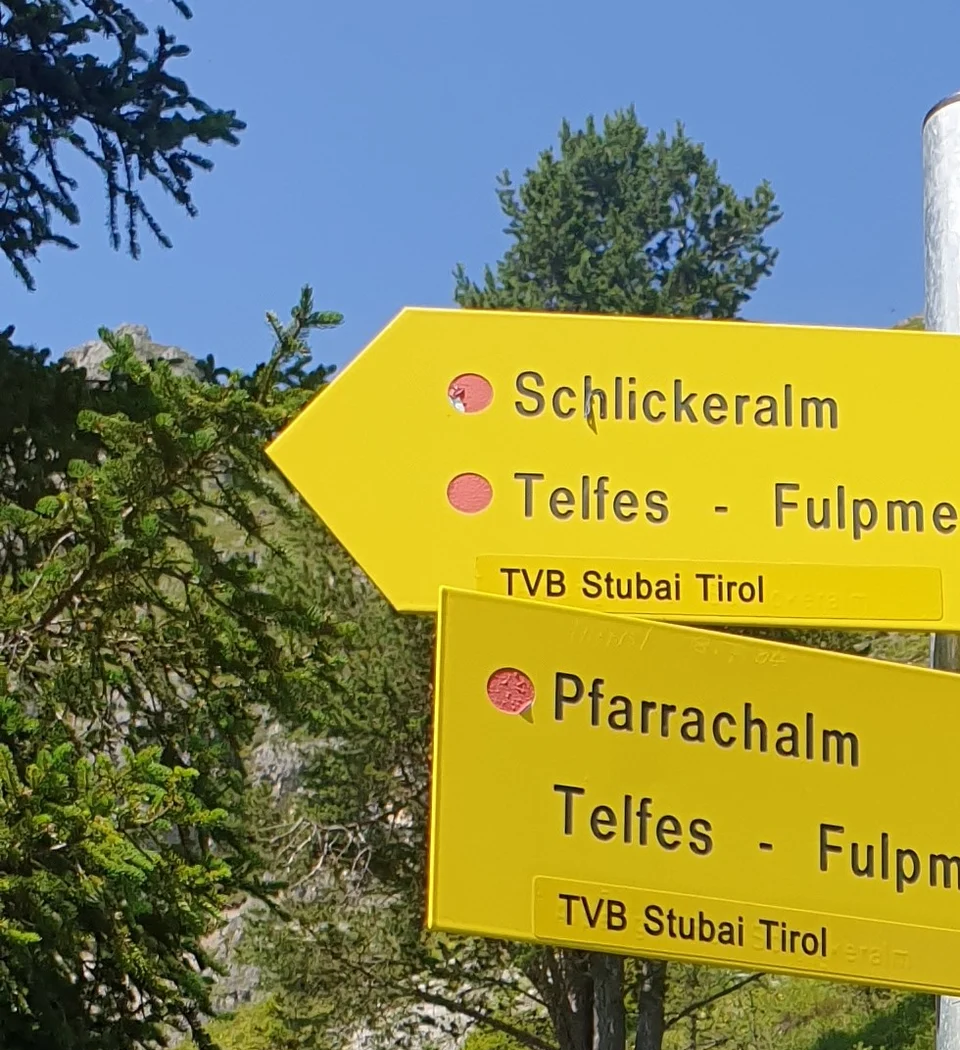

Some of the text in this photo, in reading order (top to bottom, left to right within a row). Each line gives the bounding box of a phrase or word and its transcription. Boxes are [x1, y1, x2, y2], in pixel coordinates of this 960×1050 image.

[514, 370, 838, 429] Schlickeralm
[513, 472, 669, 524] Telfes
[499, 567, 566, 598] TVB
[582, 570, 681, 601] Stubai
[695, 573, 764, 603] Tirol
[554, 671, 859, 767] Pfarrachalm
[553, 783, 713, 856] Telfes
[558, 893, 627, 931] TVB
[643, 904, 744, 947] Stubai
[758, 918, 827, 958] Tirol
